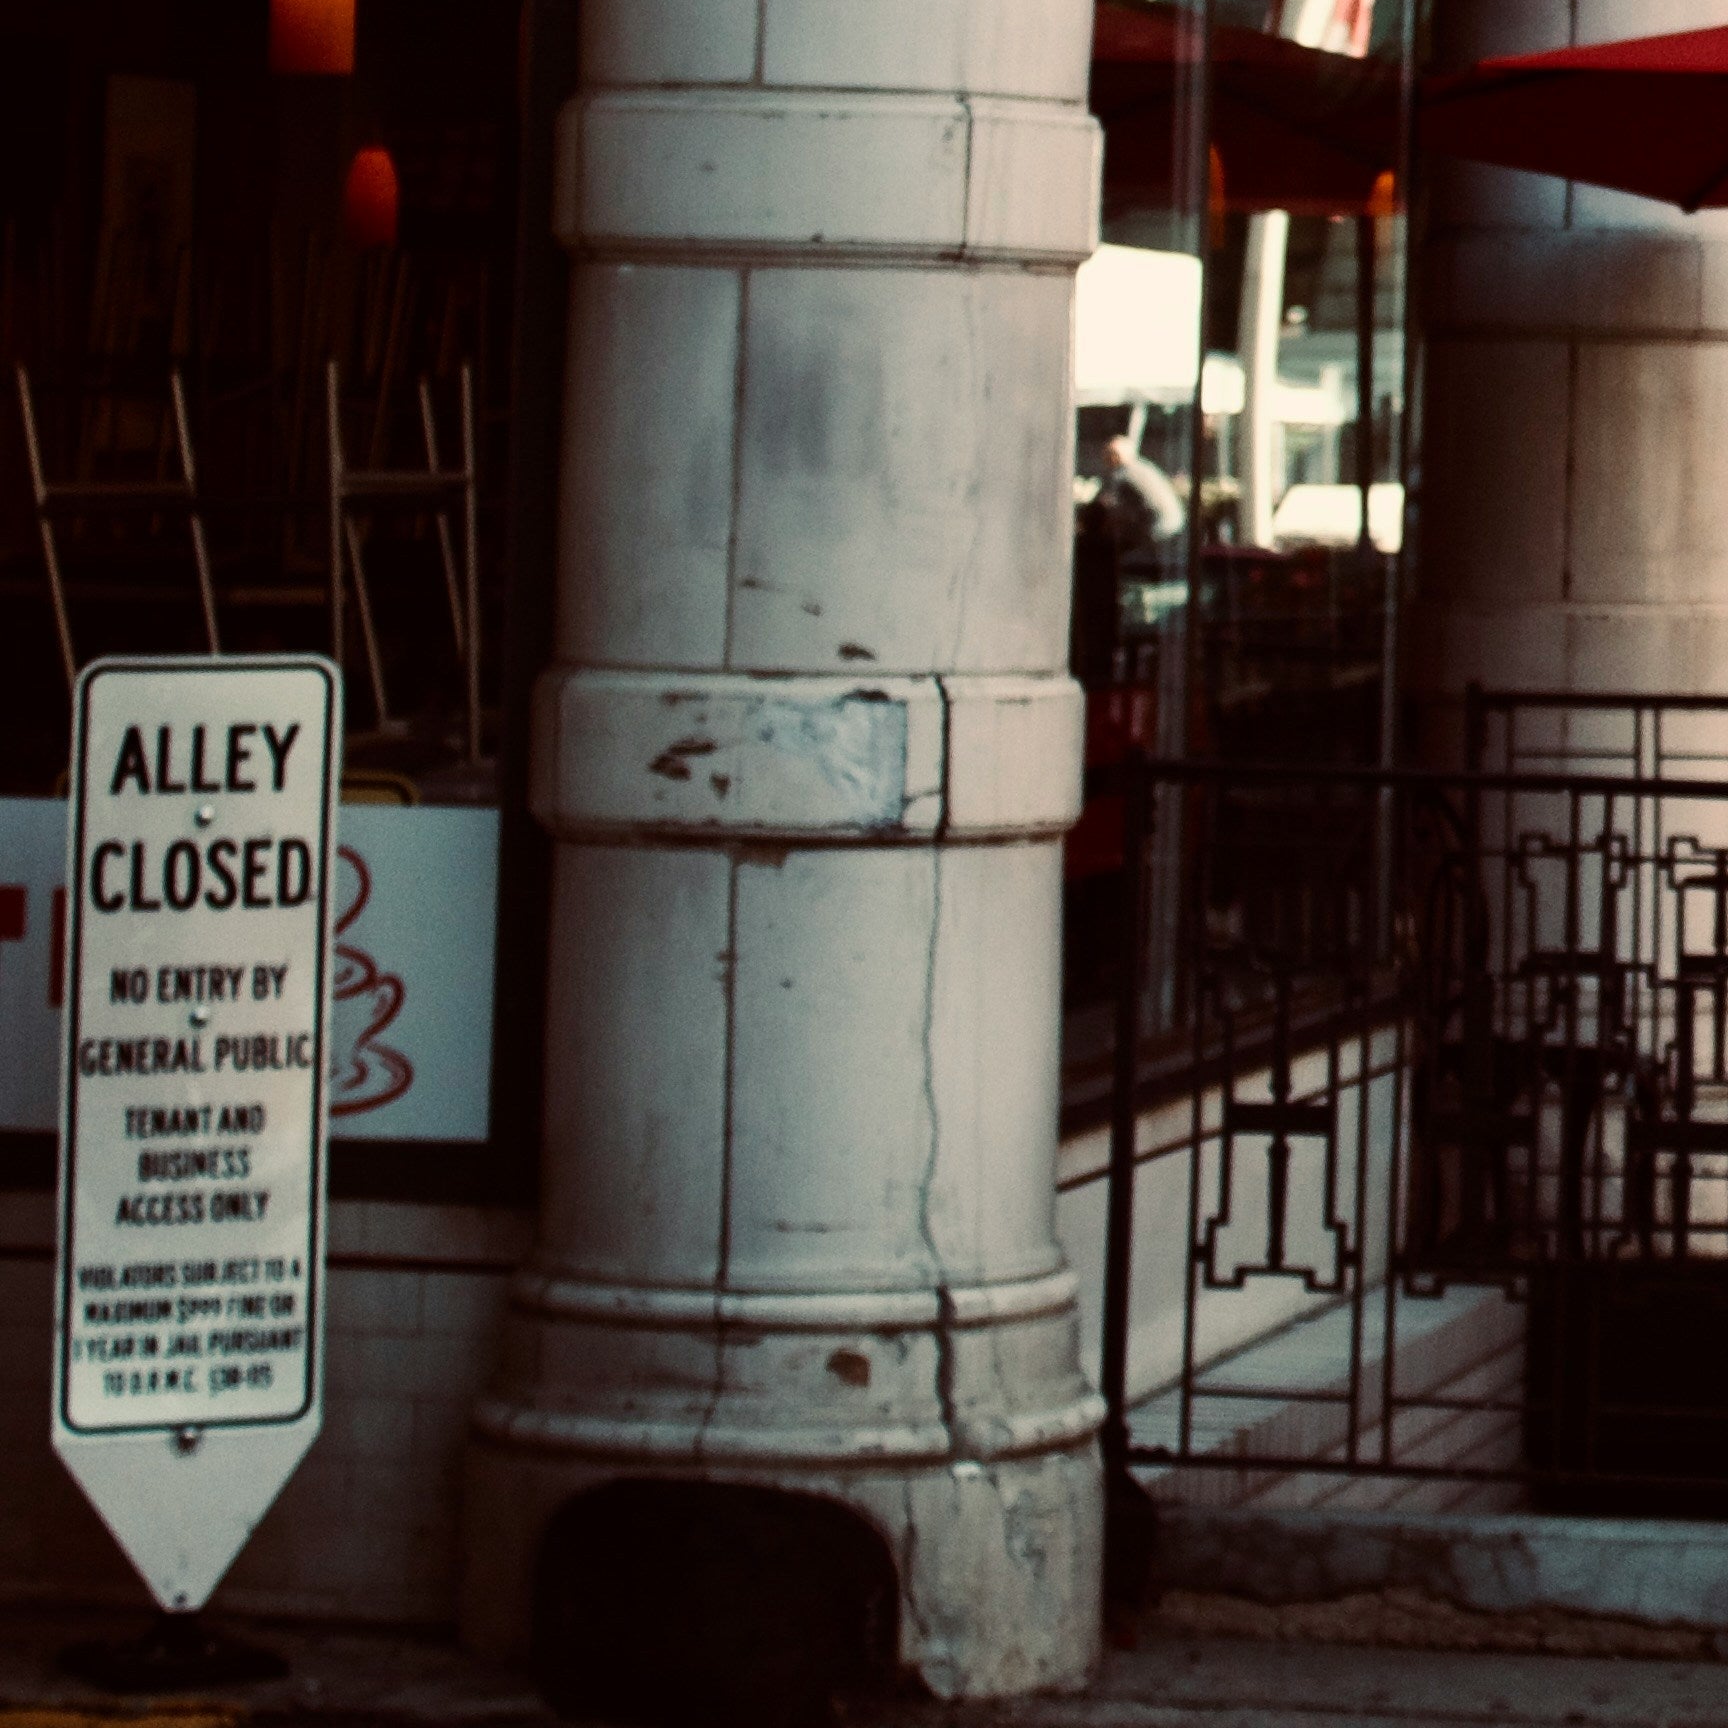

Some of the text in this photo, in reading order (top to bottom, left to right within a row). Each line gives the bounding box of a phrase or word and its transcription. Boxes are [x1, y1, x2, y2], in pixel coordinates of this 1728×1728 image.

[110, 722, 301, 796] ALLEY
[90, 838, 313, 912] CLOSED
[110, 963, 288, 1004] NO ENTRY BY
[80, 1035, 313, 1076] GENERAL PUBLIC
[126, 1104, 265, 1139] TENANT AND
[137, 1147, 251, 1182] BUSINESS
[115, 1191, 271, 1227] ACCESS ONLY
